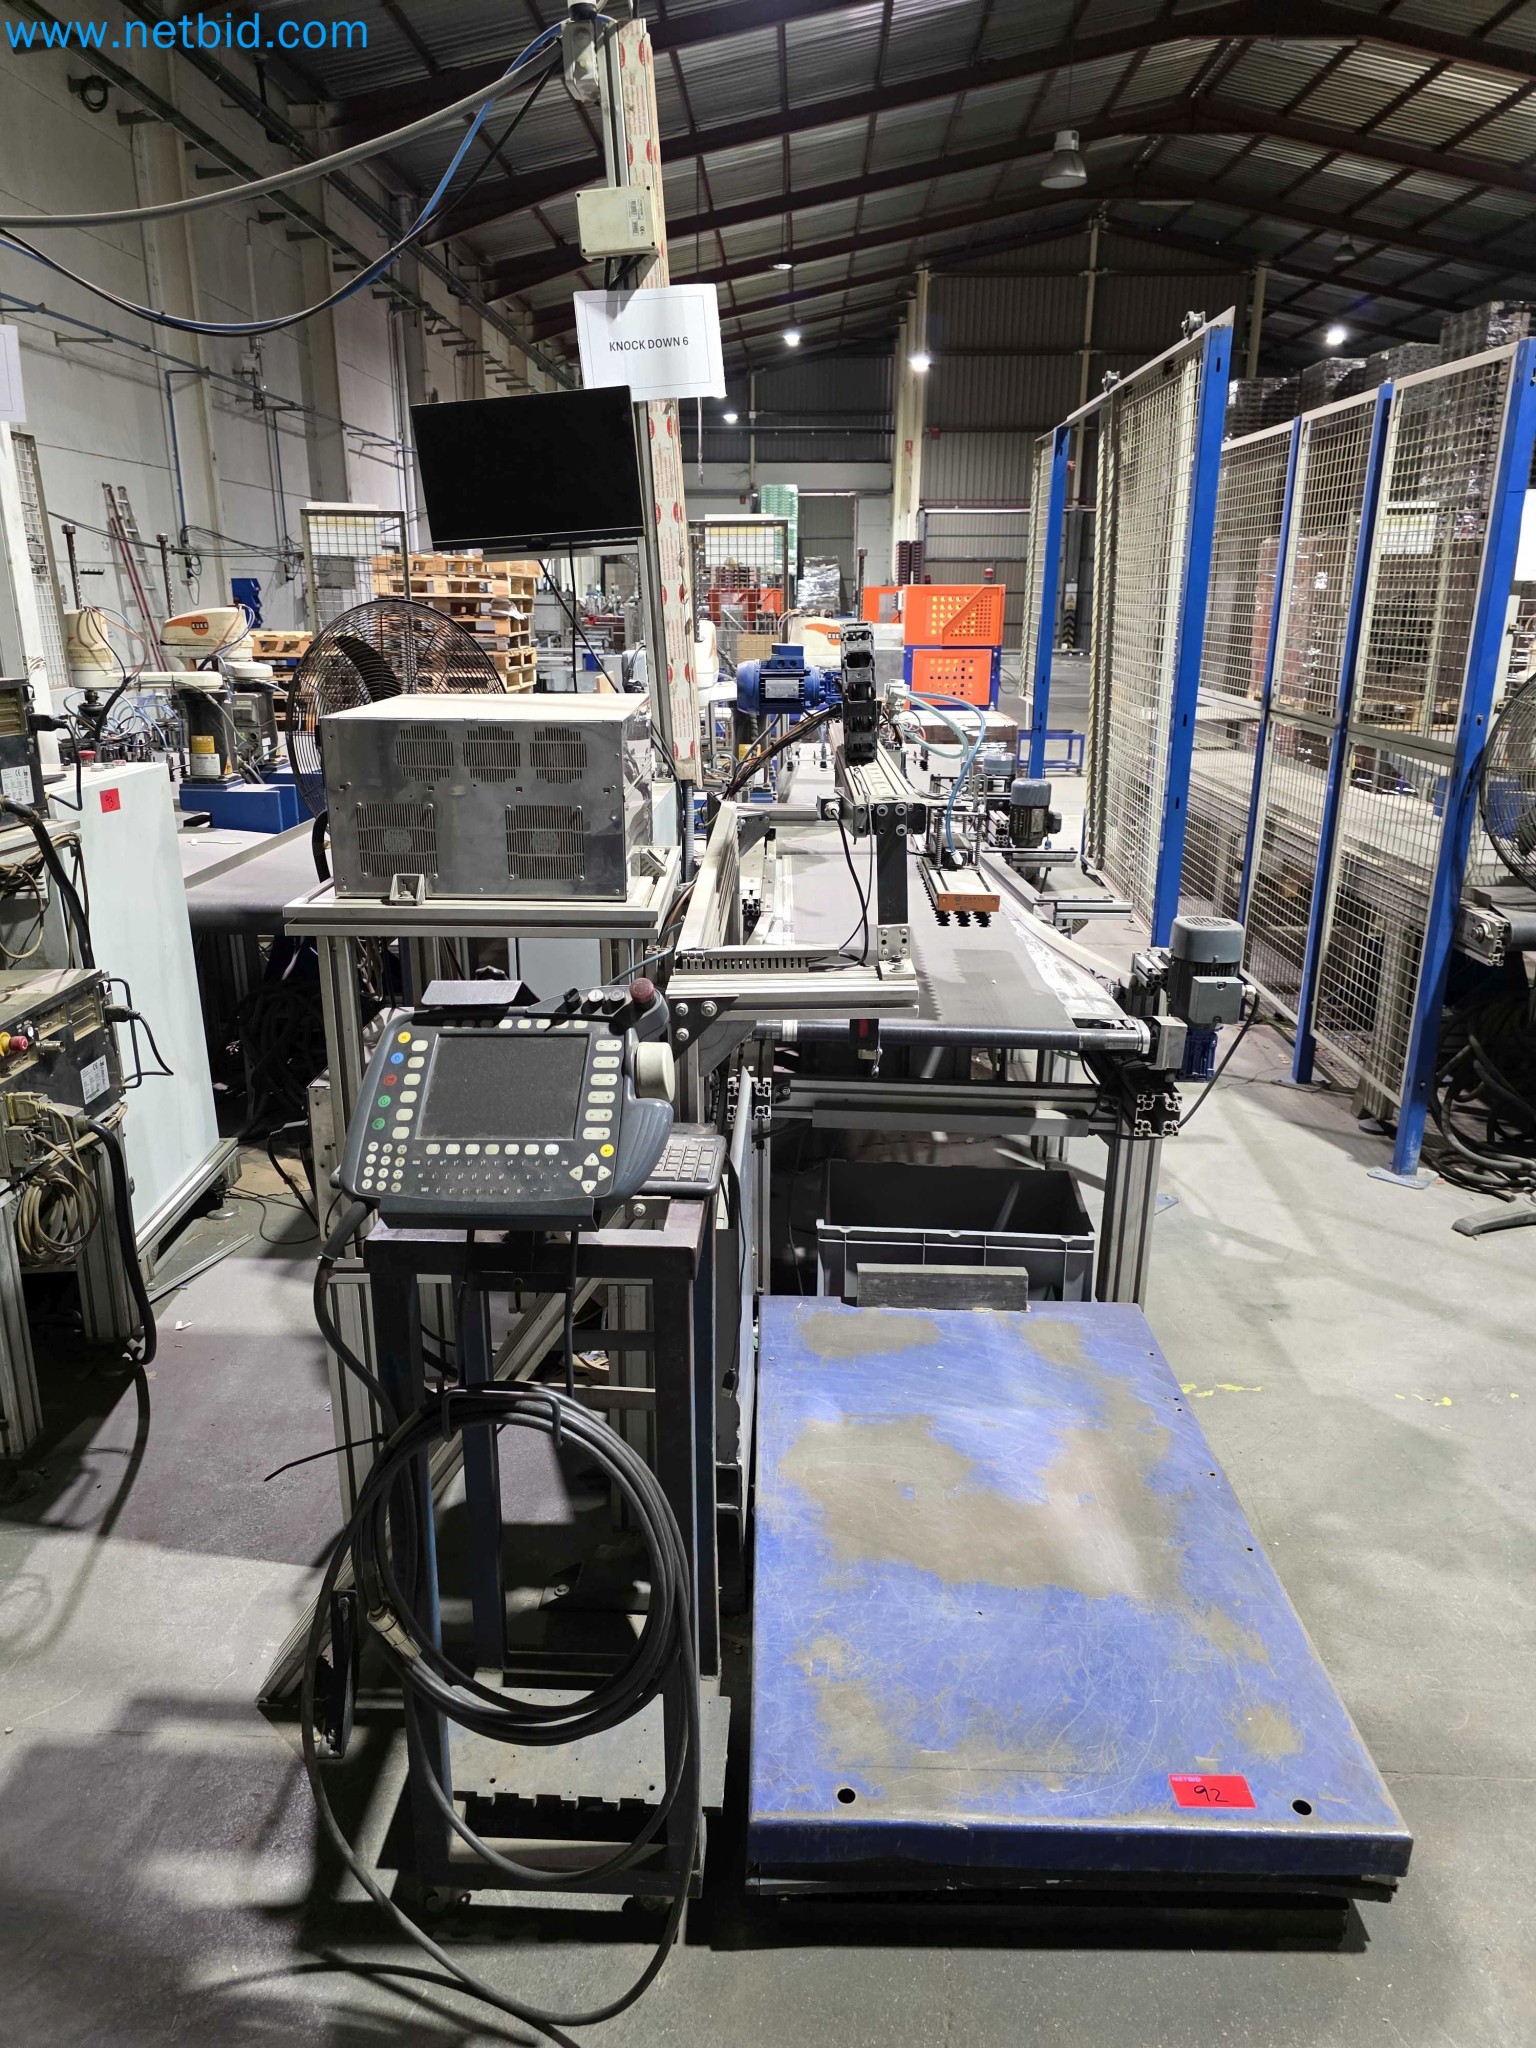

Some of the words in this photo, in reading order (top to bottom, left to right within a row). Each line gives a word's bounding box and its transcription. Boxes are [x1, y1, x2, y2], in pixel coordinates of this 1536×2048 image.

[609, 341, 645, 351] KNOCK
[648, 337, 680, 349] DOWN
[682, 336, 689, 346] 6
[1194, 1785, 1229, 1803] 92
